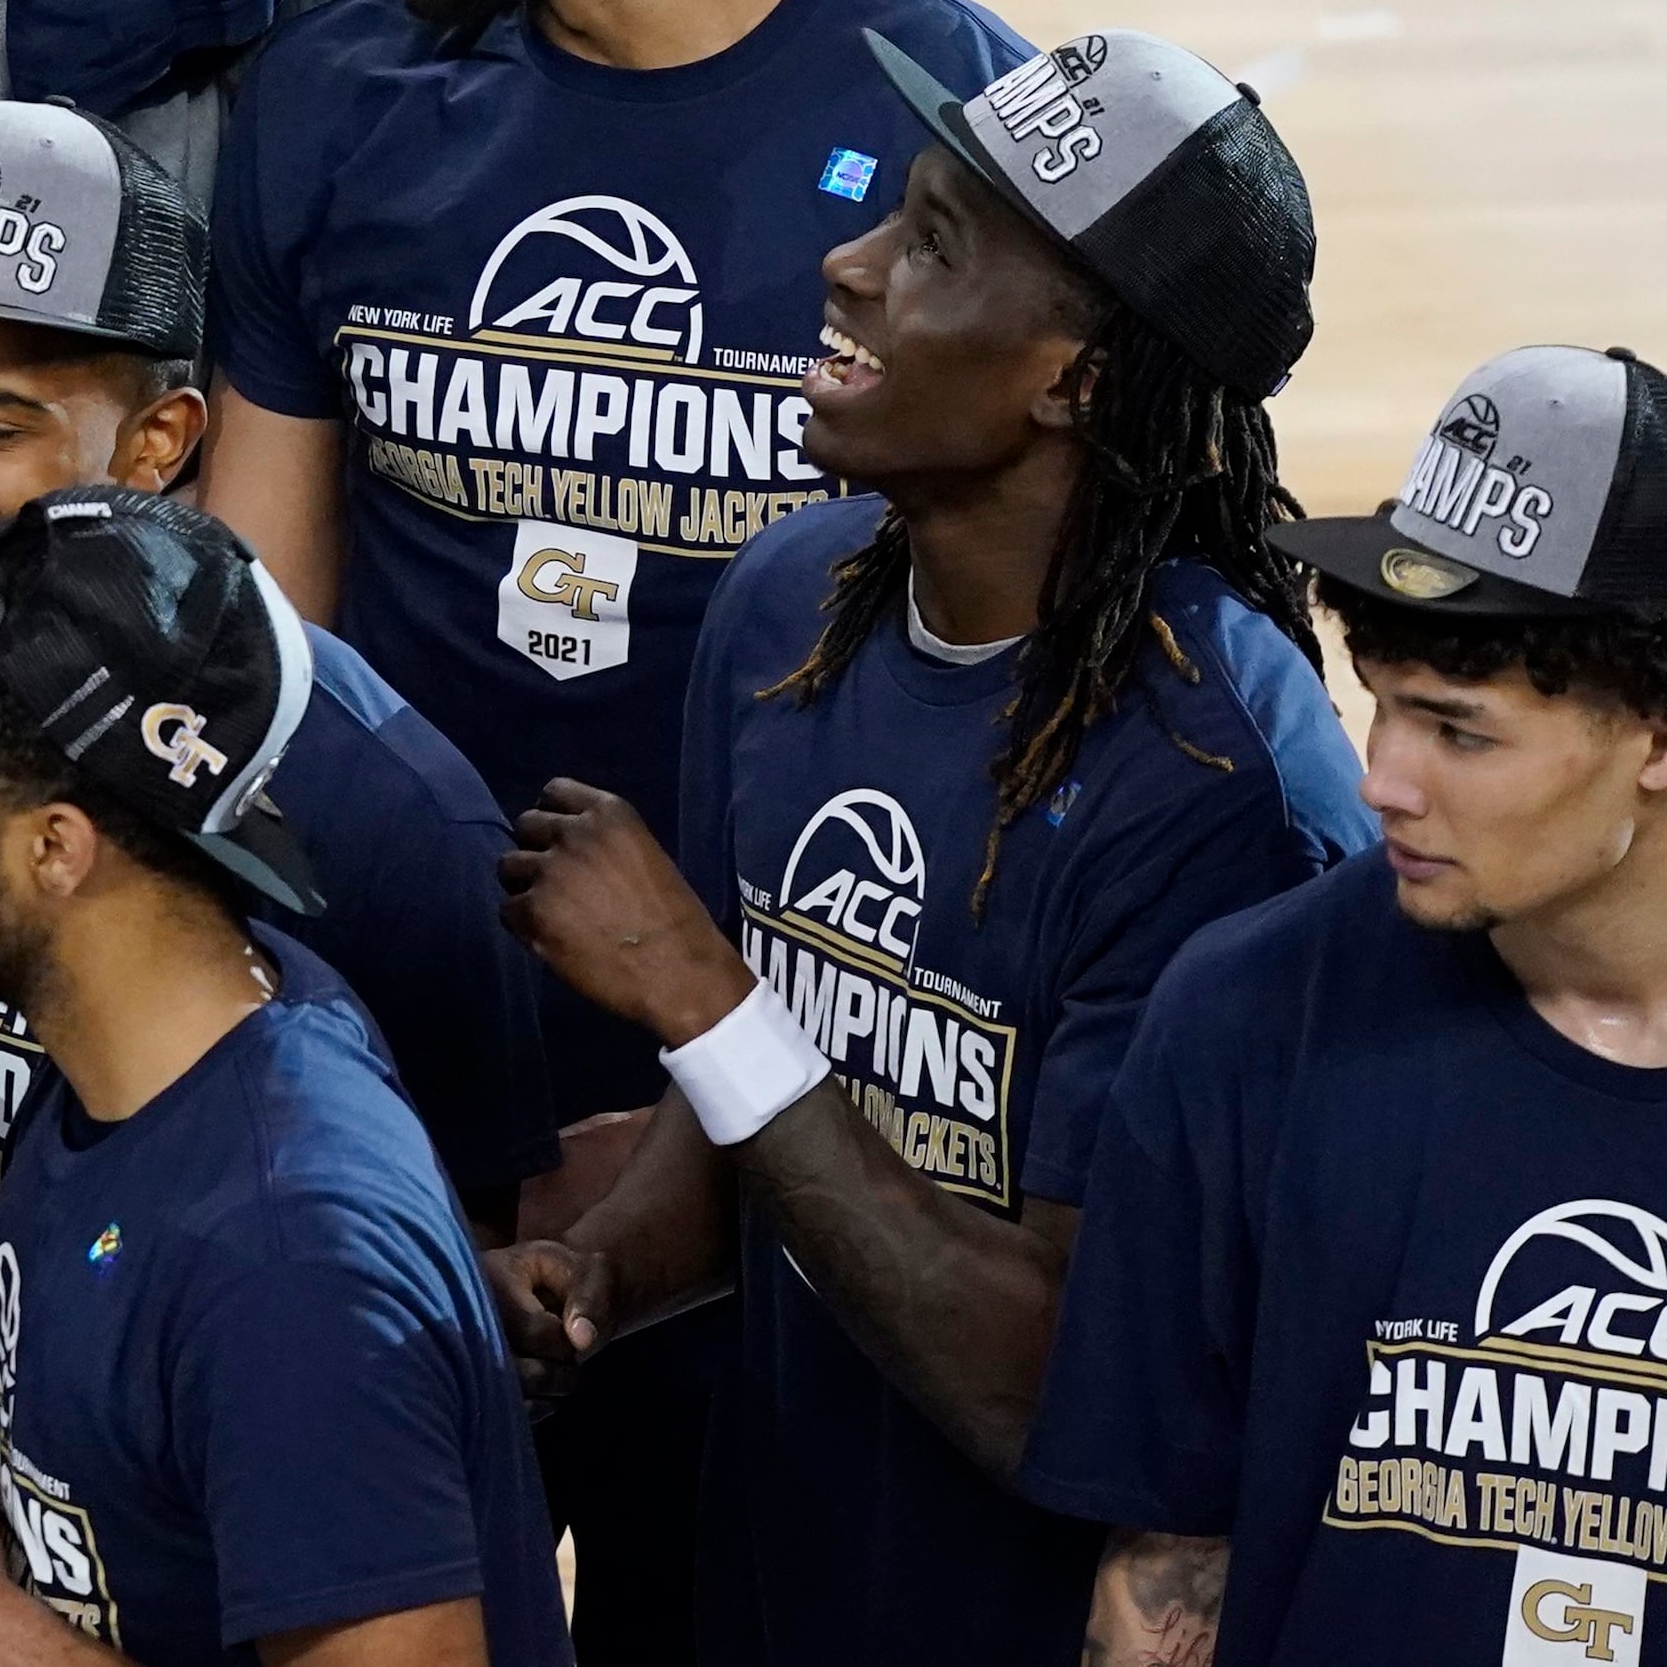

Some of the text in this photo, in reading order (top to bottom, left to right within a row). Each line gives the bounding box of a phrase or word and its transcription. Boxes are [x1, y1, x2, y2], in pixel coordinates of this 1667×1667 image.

[16, 193, 42, 214] 21
[348, 305, 454, 335] NEW YORK LIFE
[493, 277, 699, 346] ACC
[349, 342, 824, 481] CHAMPIONS
[469, 457, 544, 517] TECH
[552, 469, 673, 539] YELLOW
[517, 548, 618, 622] GT
[527, 630, 592, 667] 2021
[140, 702, 229, 789] GT
[794, 868, 923, 959] ACC
[914, 967, 1002, 1020] TOURNAMENT
[1384, 1319, 1424, 1340] YORK
[1427, 1320, 1459, 1343] LIFE
[1500, 1285, 1667, 1358] AC
[1336, 1455, 1468, 1531] GEORGIA
[1476, 1472, 1557, 1543] TECH
[1521, 1579, 1634, 1662] GT
